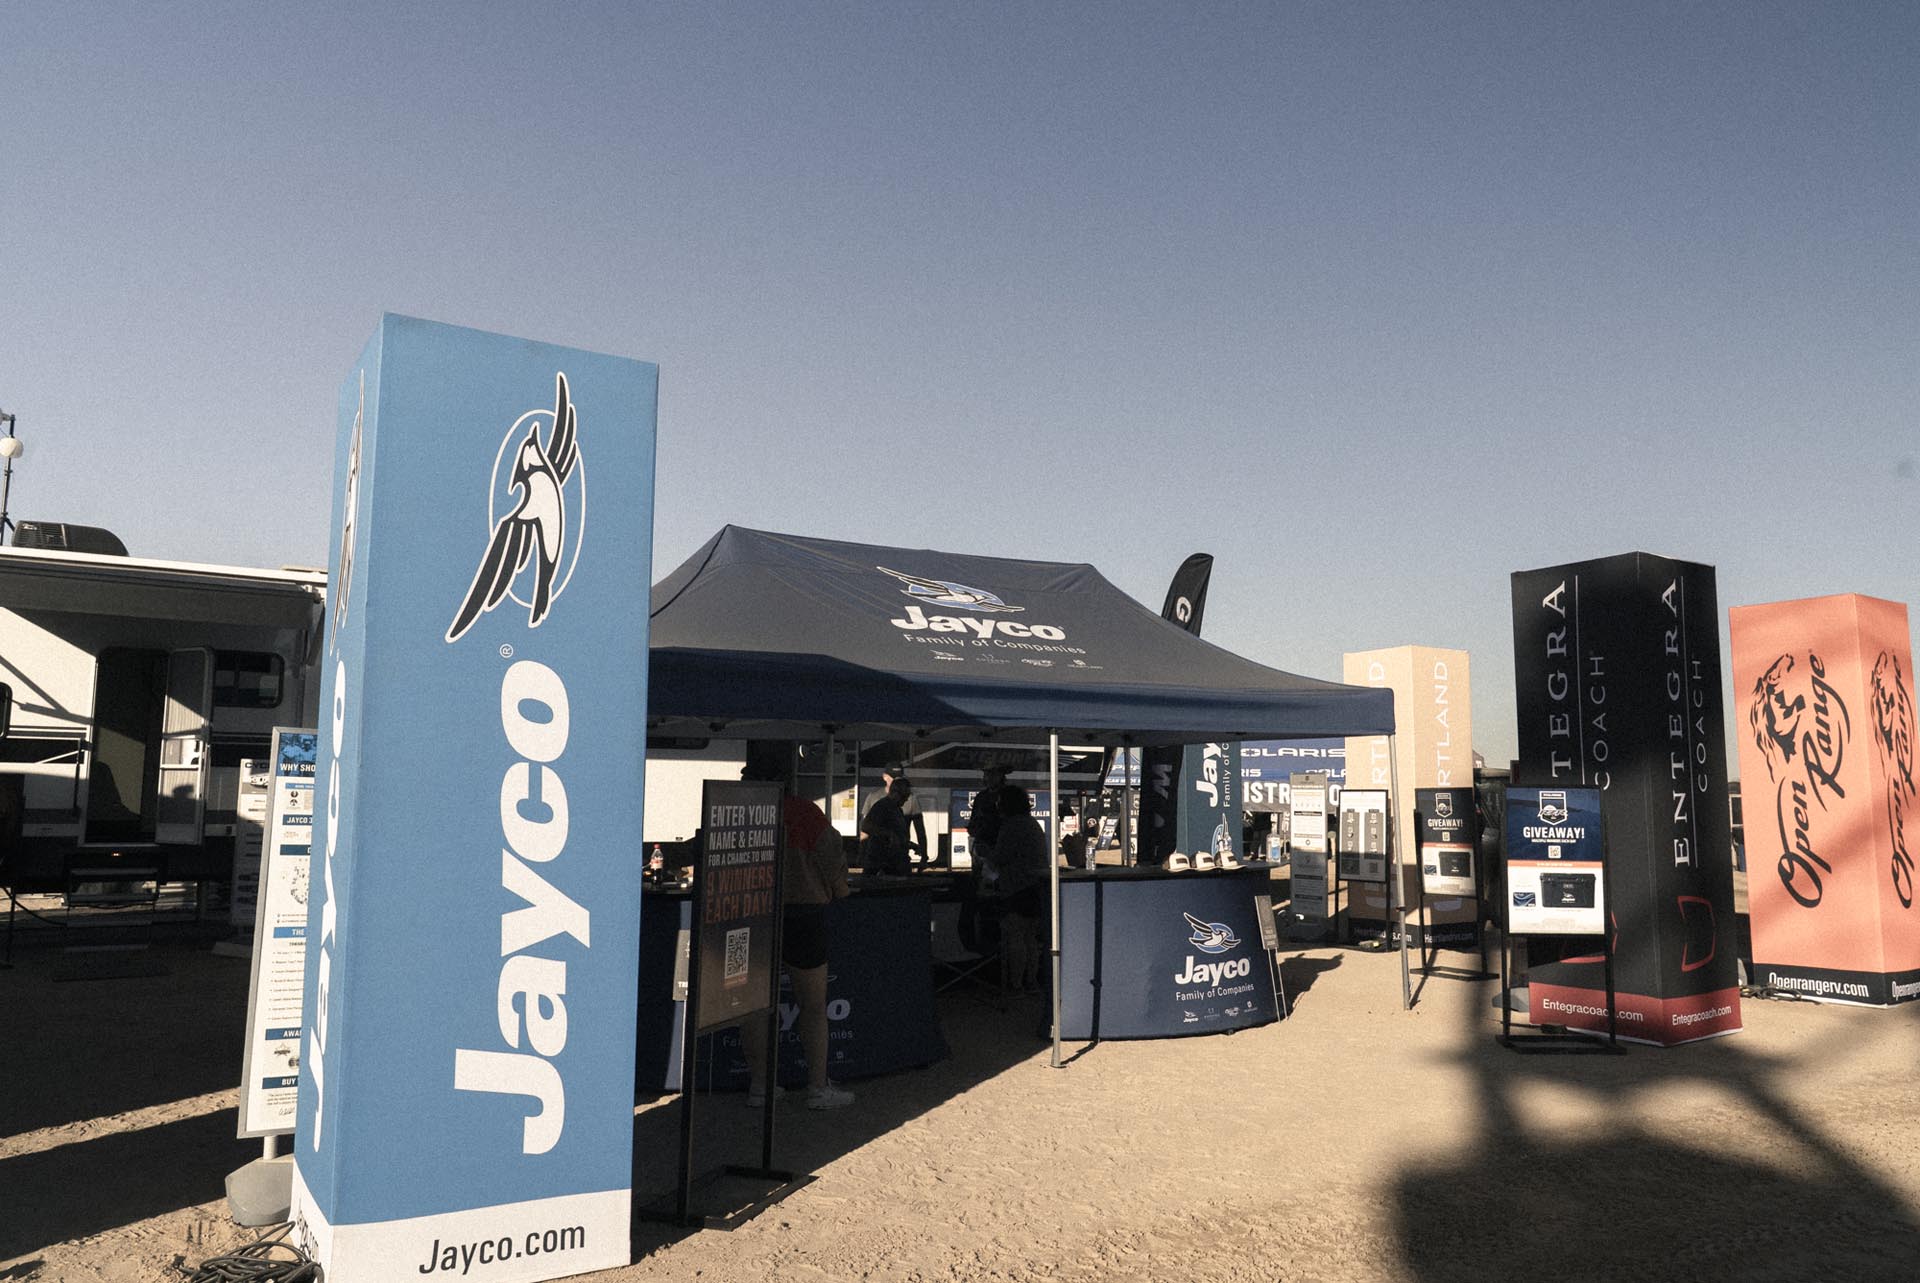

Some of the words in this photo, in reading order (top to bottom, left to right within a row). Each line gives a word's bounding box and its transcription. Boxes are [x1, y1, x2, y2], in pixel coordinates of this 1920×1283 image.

[891, 606, 1066, 639] Jayco
[903, 633, 965, 647] Family
[971, 639, 989, 647] of
[994, 639, 1086, 654] Companies
[1589, 656, 1610, 791] COACH
[1661, 579, 1690, 868] ENTEGRA
[1691, 659, 1708, 793] COACH
[1802, 653, 1851, 812] Range
[279, 763, 298, 772] WHY
[1222, 753, 1230, 766] of
[1222, 766, 1231, 808] Family
[286, 816, 308, 824] JAYCO
[710, 805, 745, 828] ENTER
[748, 804, 776, 826] YOUR
[1427, 818, 1464, 829] GIVEAWAY!
[709, 831, 737, 851] NAME
[738, 831, 746, 848] &
[748, 829, 775, 847] EMAIL
[1523, 826, 1585, 839] GIVEAWAY!
[1777, 776, 1832, 909] Open
[1887, 775, 1915, 909] Open
[708, 854, 720, 867] FOR
[721, 853, 727, 866] A
[727, 852, 751, 865] CHANCE
[752, 851, 760, 862] TO
[718, 865, 774, 894] WINNERS
[308, 660, 345, 1153] Jayco
[453, 659, 590, 1155] Jayco
[705, 893, 739, 925] EACH
[743, 890, 773, 919] DAY!
[1174, 955, 1251, 987] Jayco
[1768, 971, 1870, 998] Openrangerv.com
[1175, 989, 1205, 1001] Family
[1207, 987, 1216, 998] of
[1217, 983, 1255, 996] Companies
[1542, 998, 1644, 1023] Entegracoac.com
[1672, 1005, 1732, 1026] Entegracoach.com
[281, 1077, 296, 1086] BUY
[418, 1225, 586, 1275] Jayco.com
